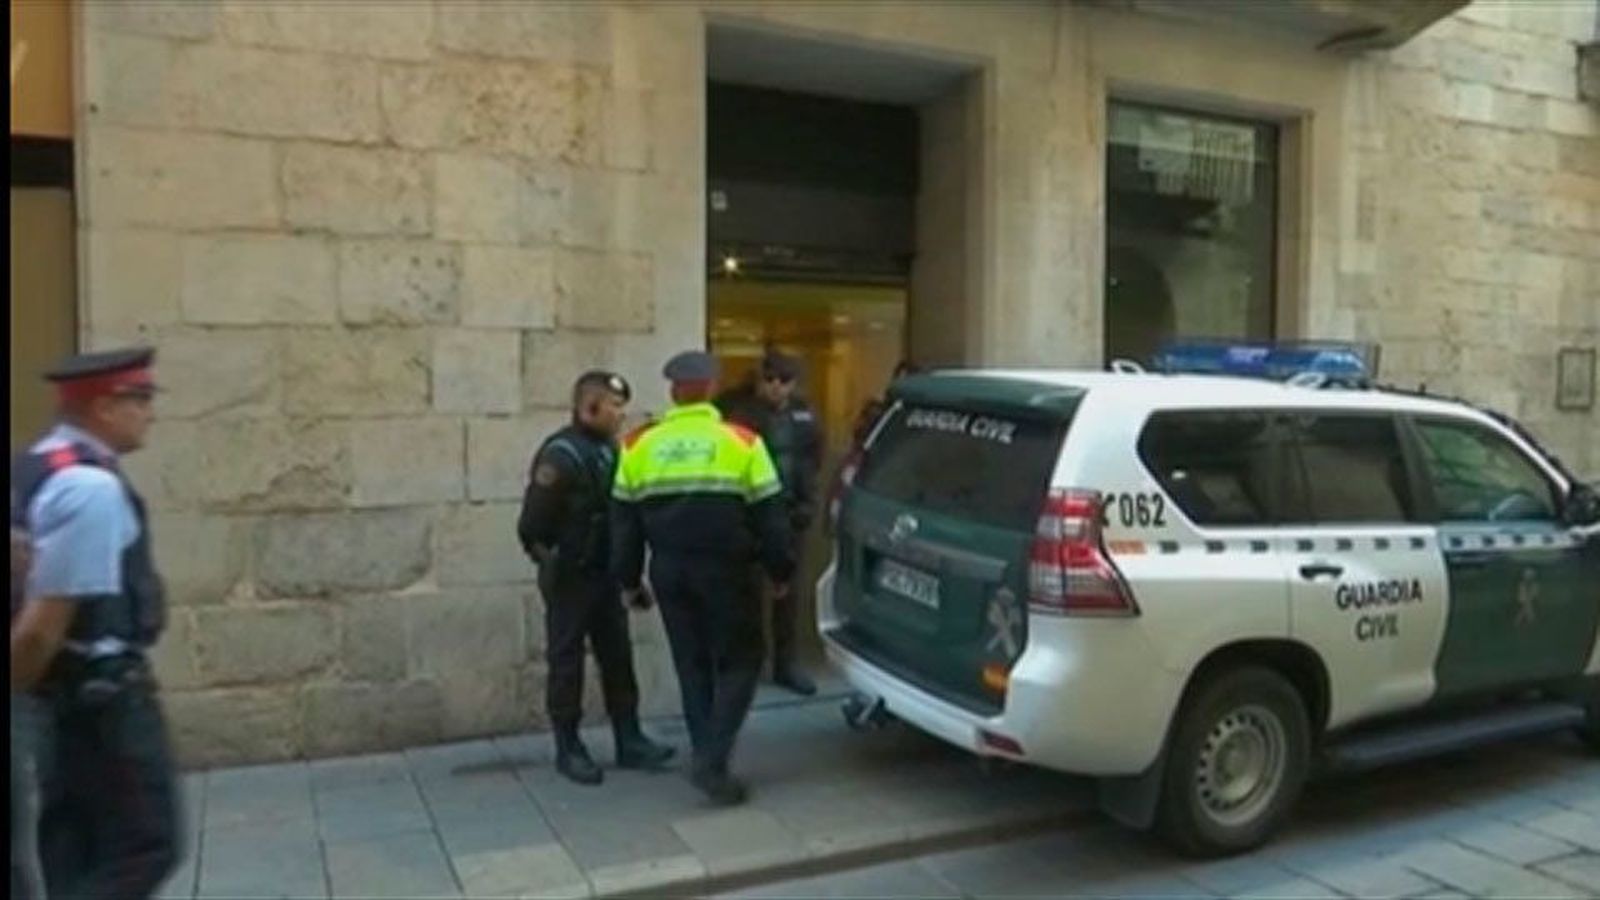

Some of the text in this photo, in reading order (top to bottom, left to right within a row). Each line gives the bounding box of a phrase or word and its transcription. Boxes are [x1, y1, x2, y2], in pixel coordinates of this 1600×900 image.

[1119, 491, 1167, 528] 062
[1336, 579, 1423, 611] GUARDIA
[1356, 613, 1399, 642] CIVIL
